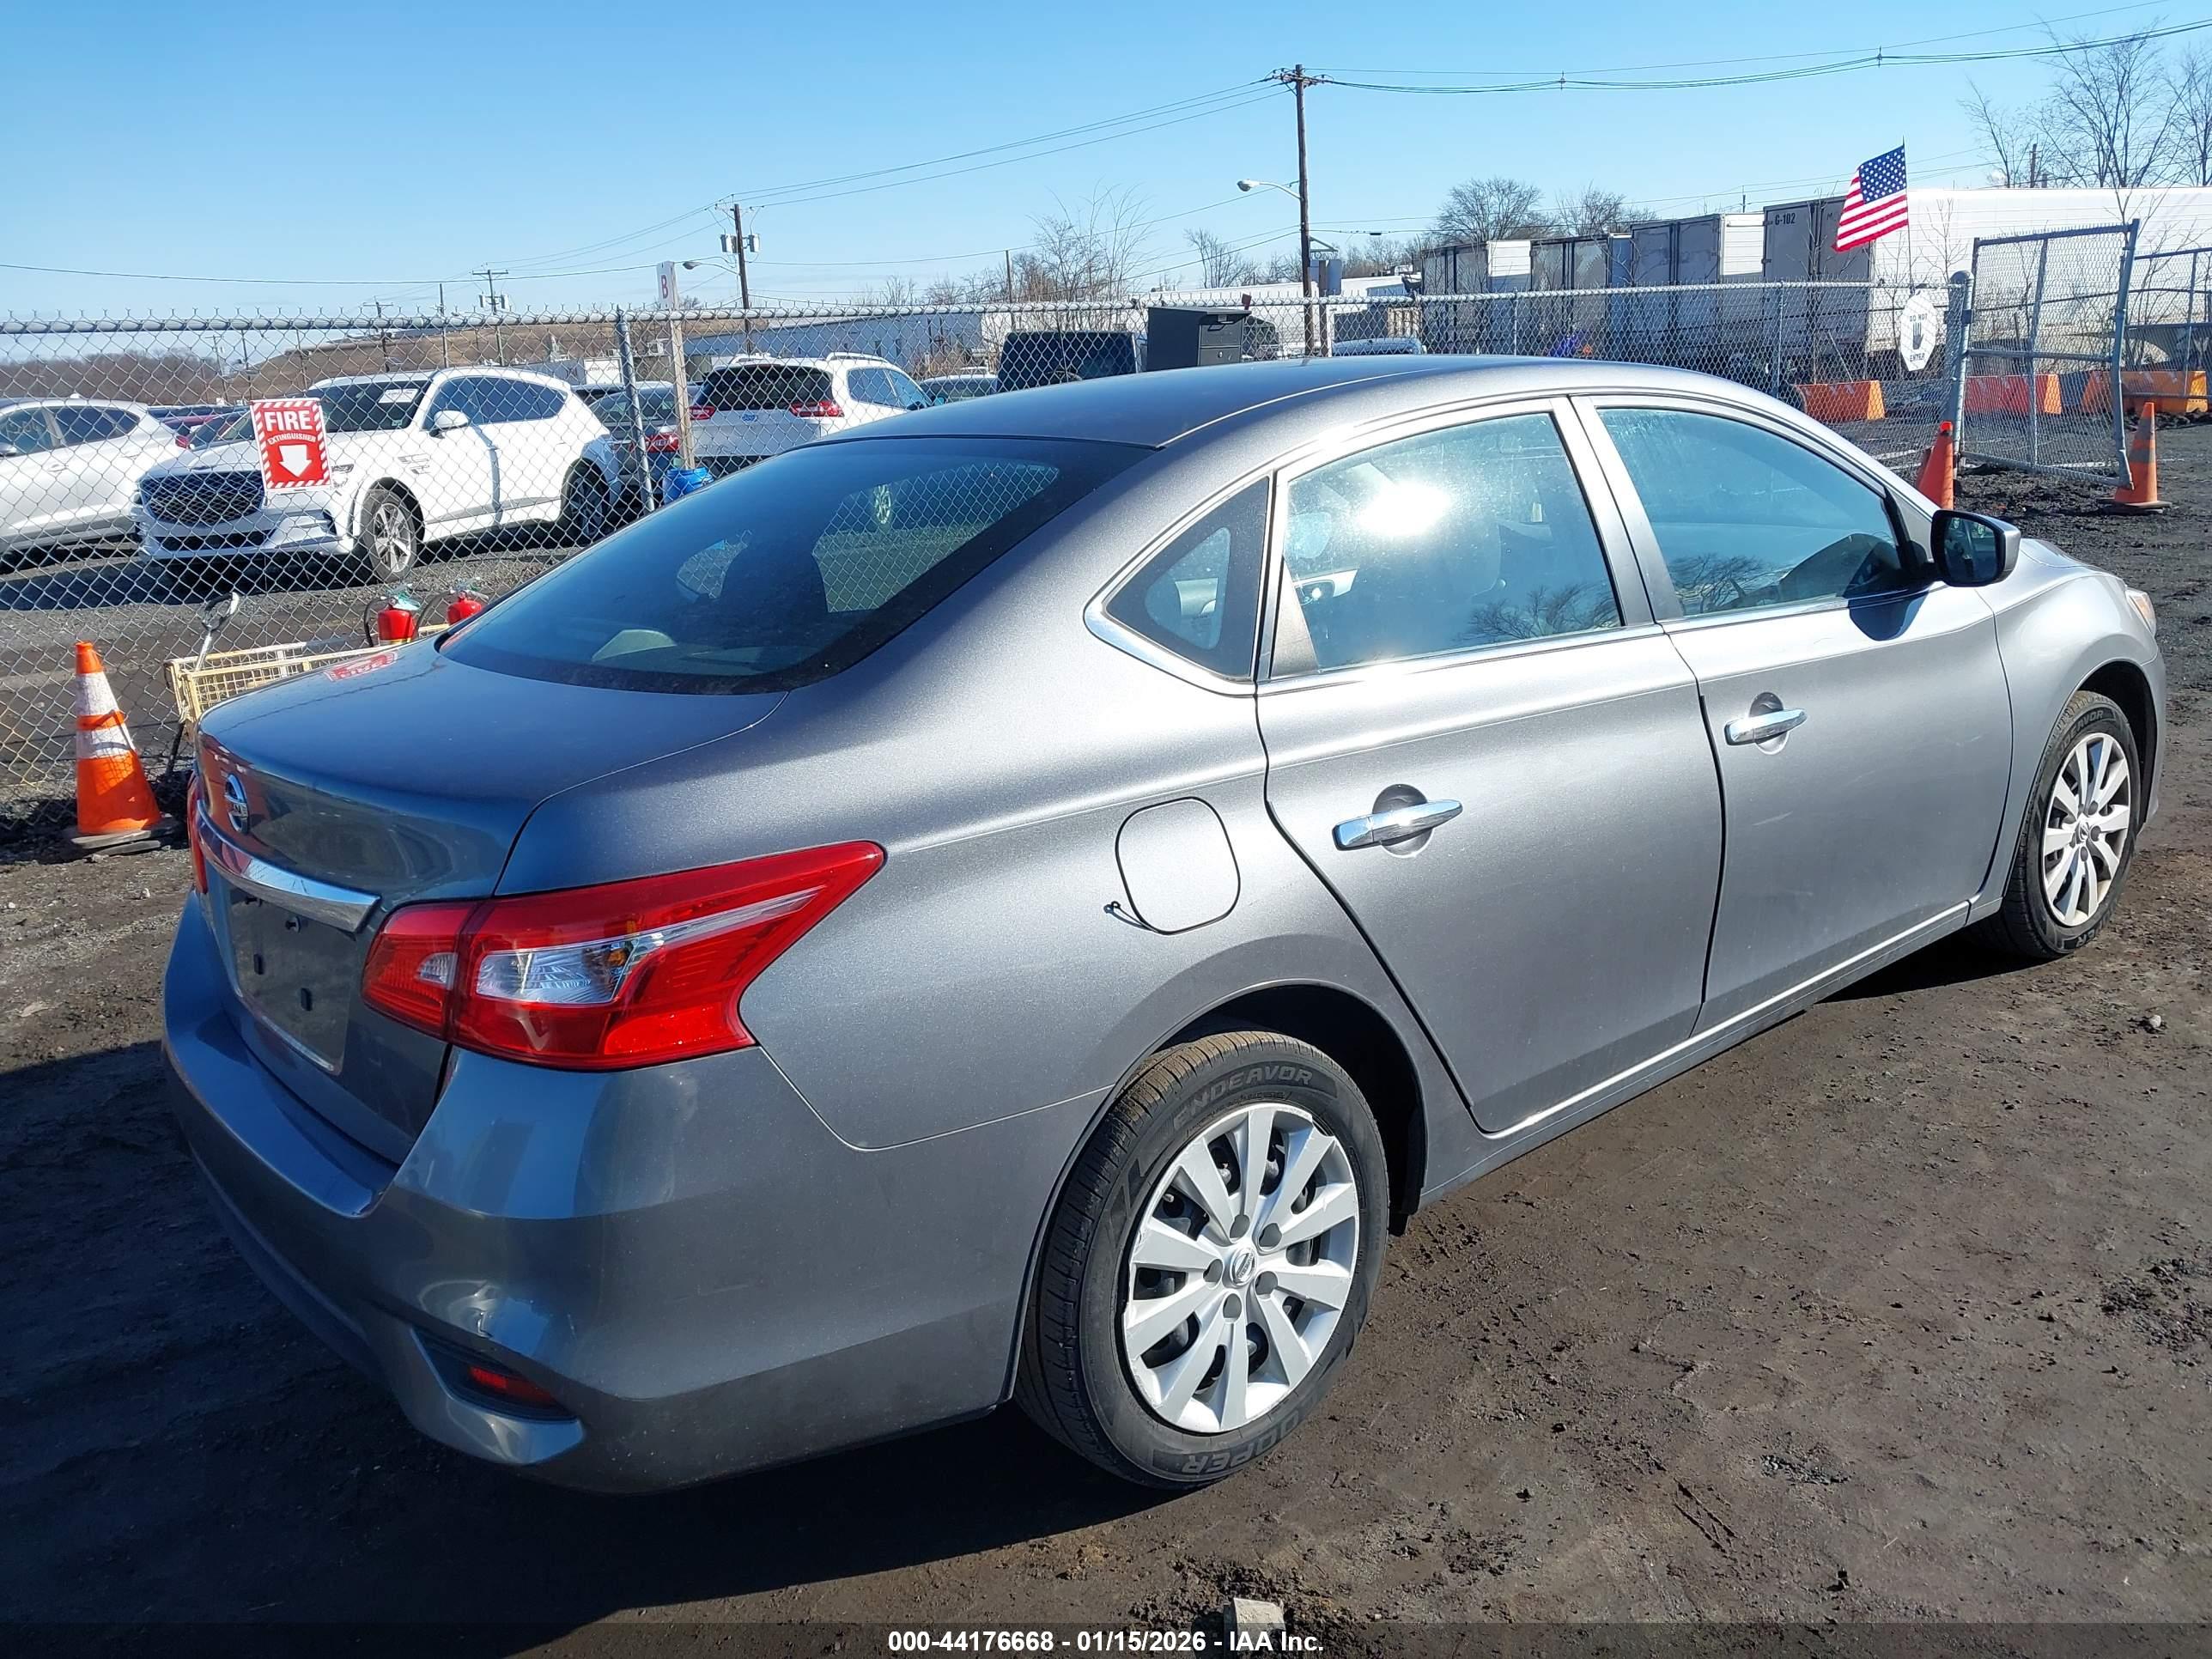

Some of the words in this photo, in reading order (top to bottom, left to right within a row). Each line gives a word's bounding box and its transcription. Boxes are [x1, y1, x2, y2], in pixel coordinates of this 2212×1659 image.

[1774, 212, 1796, 226] G-102
[661, 274, 669, 299] B
[1917, 313, 1928, 321] NOT
[1909, 353, 1925, 362] ENTER
[264, 410, 313, 431] FIRE
[266, 432, 317, 445] EXTINGUISHER
[1174, 1066, 1313, 1130] ENDEAVOR
